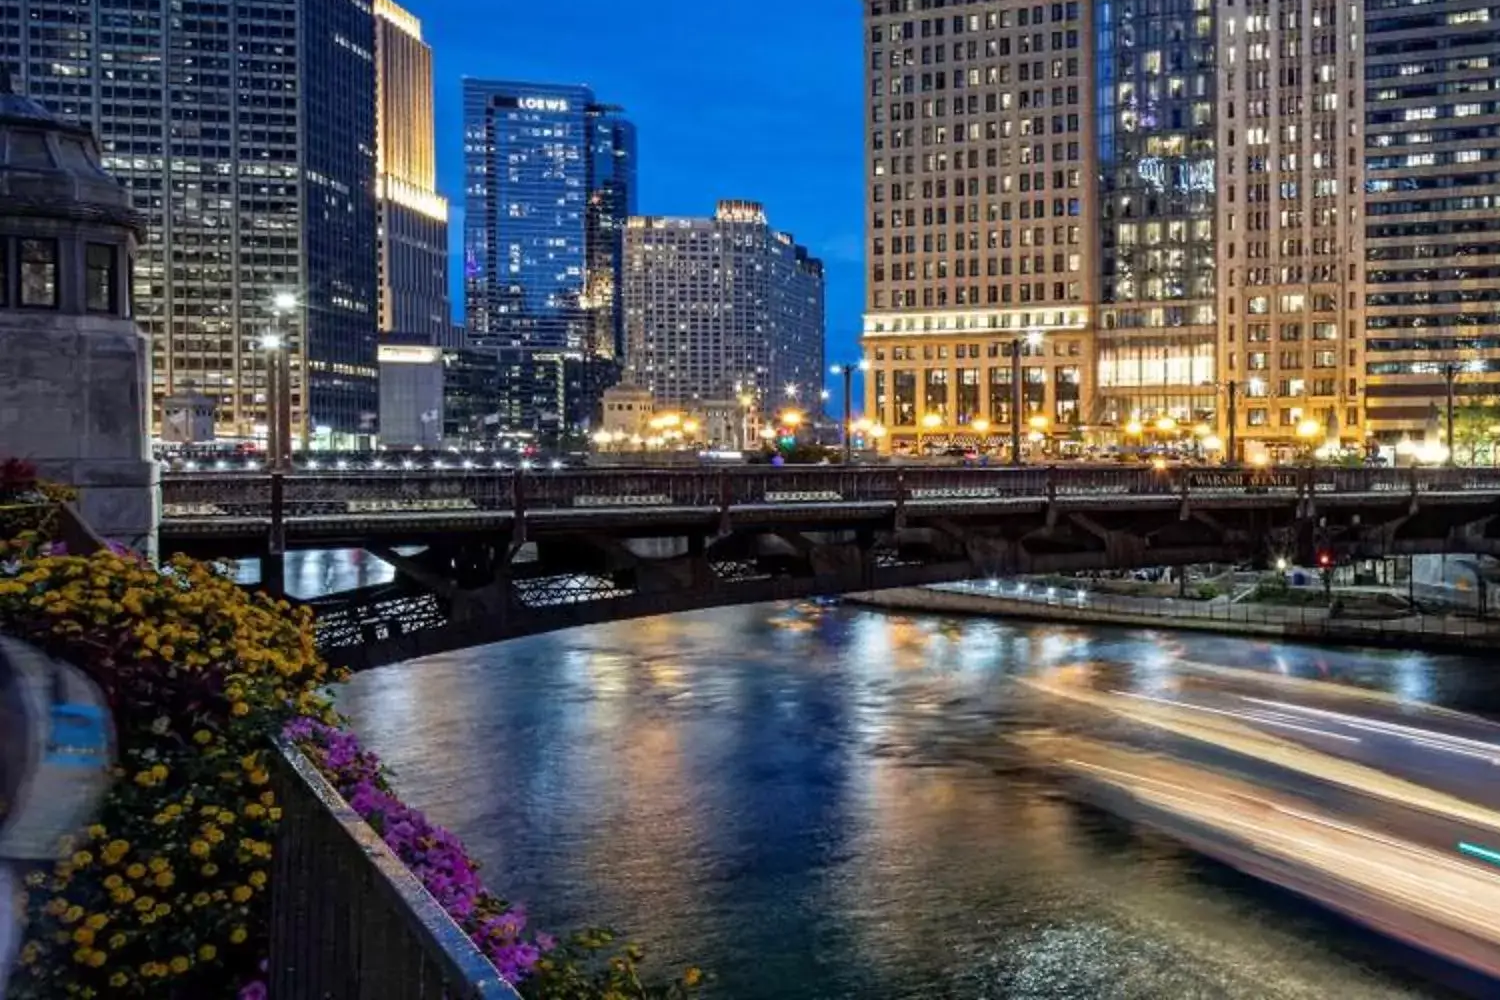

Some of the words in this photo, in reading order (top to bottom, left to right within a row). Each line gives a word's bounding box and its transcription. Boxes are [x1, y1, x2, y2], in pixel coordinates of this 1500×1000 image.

[518, 97, 569, 112] LOEWS
[1195, 474, 1243, 486] WABASH
[1249, 474, 1290, 486] AVENUE
